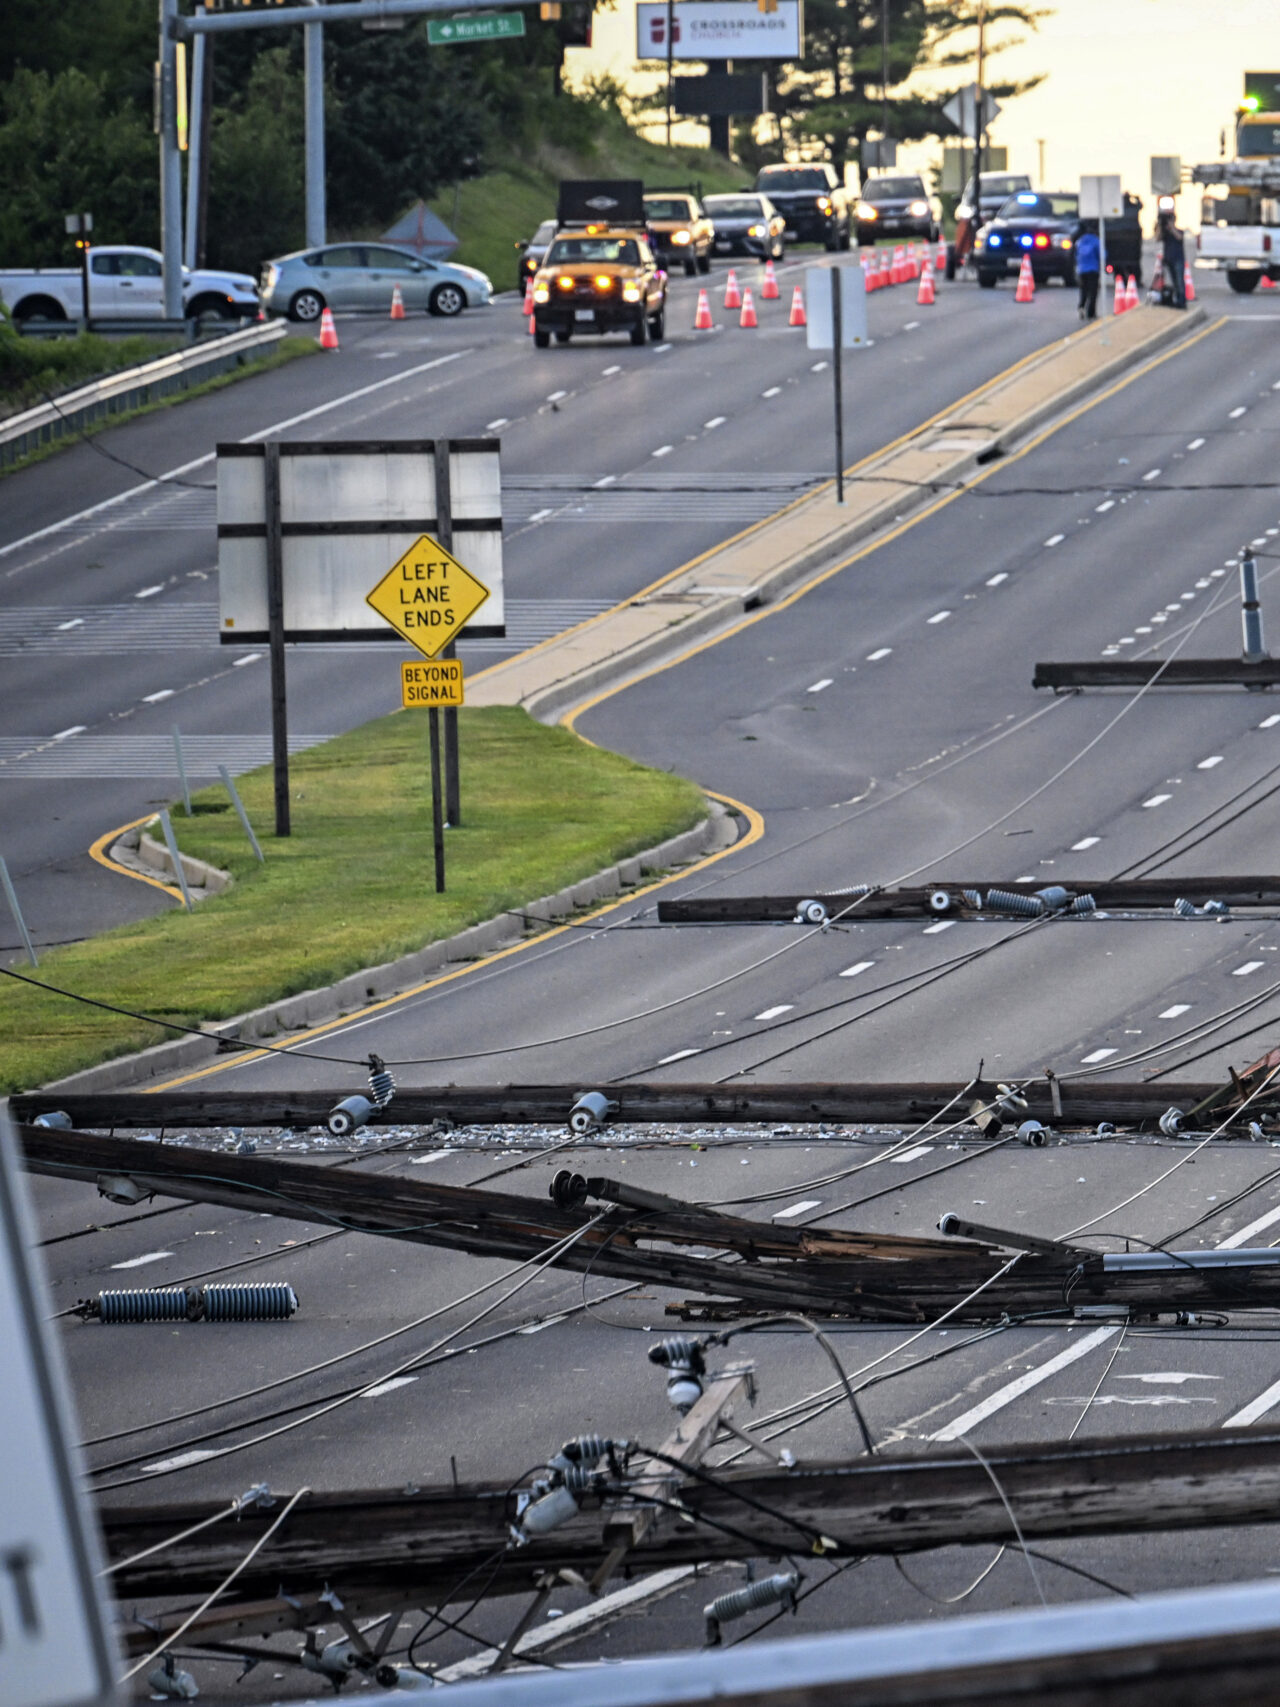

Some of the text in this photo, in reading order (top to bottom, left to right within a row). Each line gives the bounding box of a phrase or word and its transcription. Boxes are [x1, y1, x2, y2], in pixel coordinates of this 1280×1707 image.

[456, 20, 494, 36] Market
[690, 18, 786, 30] CROSSROADS
[402, 562, 449, 581] LEFT
[400, 586, 450, 604] LANE
[404, 609, 455, 628] ENDS
[405, 667, 458, 683] BEYOND
[407, 685, 457, 701] SIGNAL
